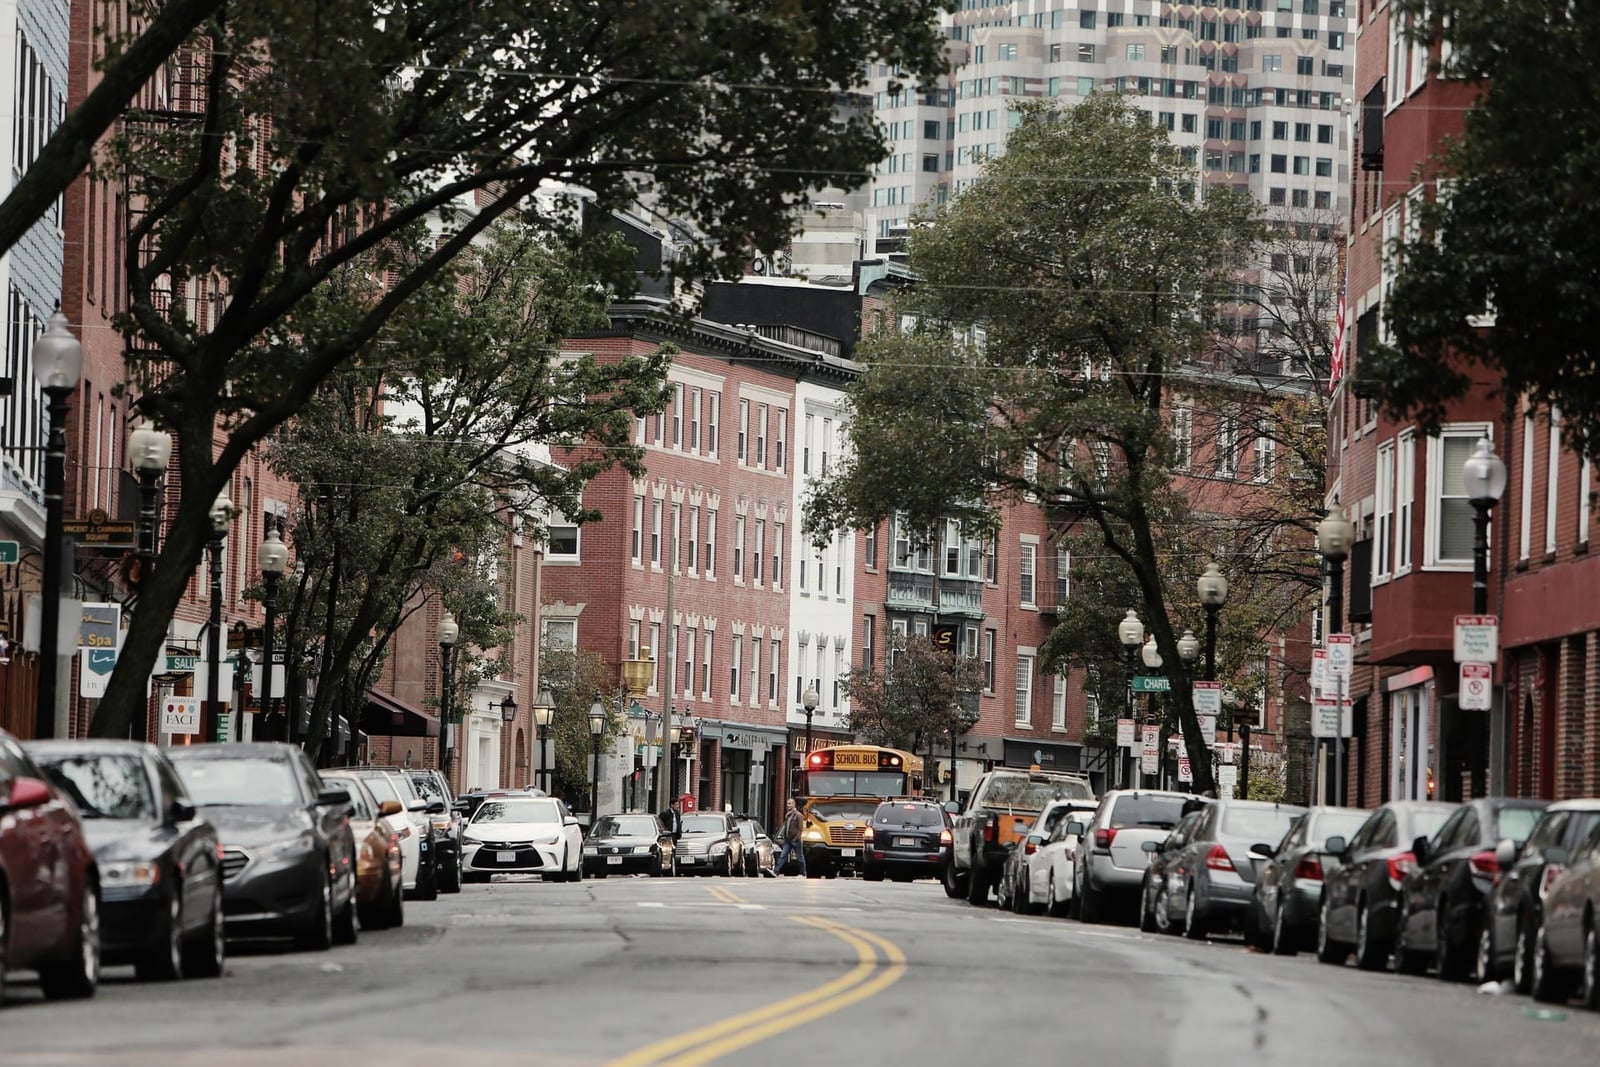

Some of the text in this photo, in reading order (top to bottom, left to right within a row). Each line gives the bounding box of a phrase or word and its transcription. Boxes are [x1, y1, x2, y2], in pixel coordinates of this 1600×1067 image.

[88, 633, 112, 648] Spa
[1144, 678, 1171, 690] CHARTE
[835, 753, 877, 765] SCHOOL BUS
